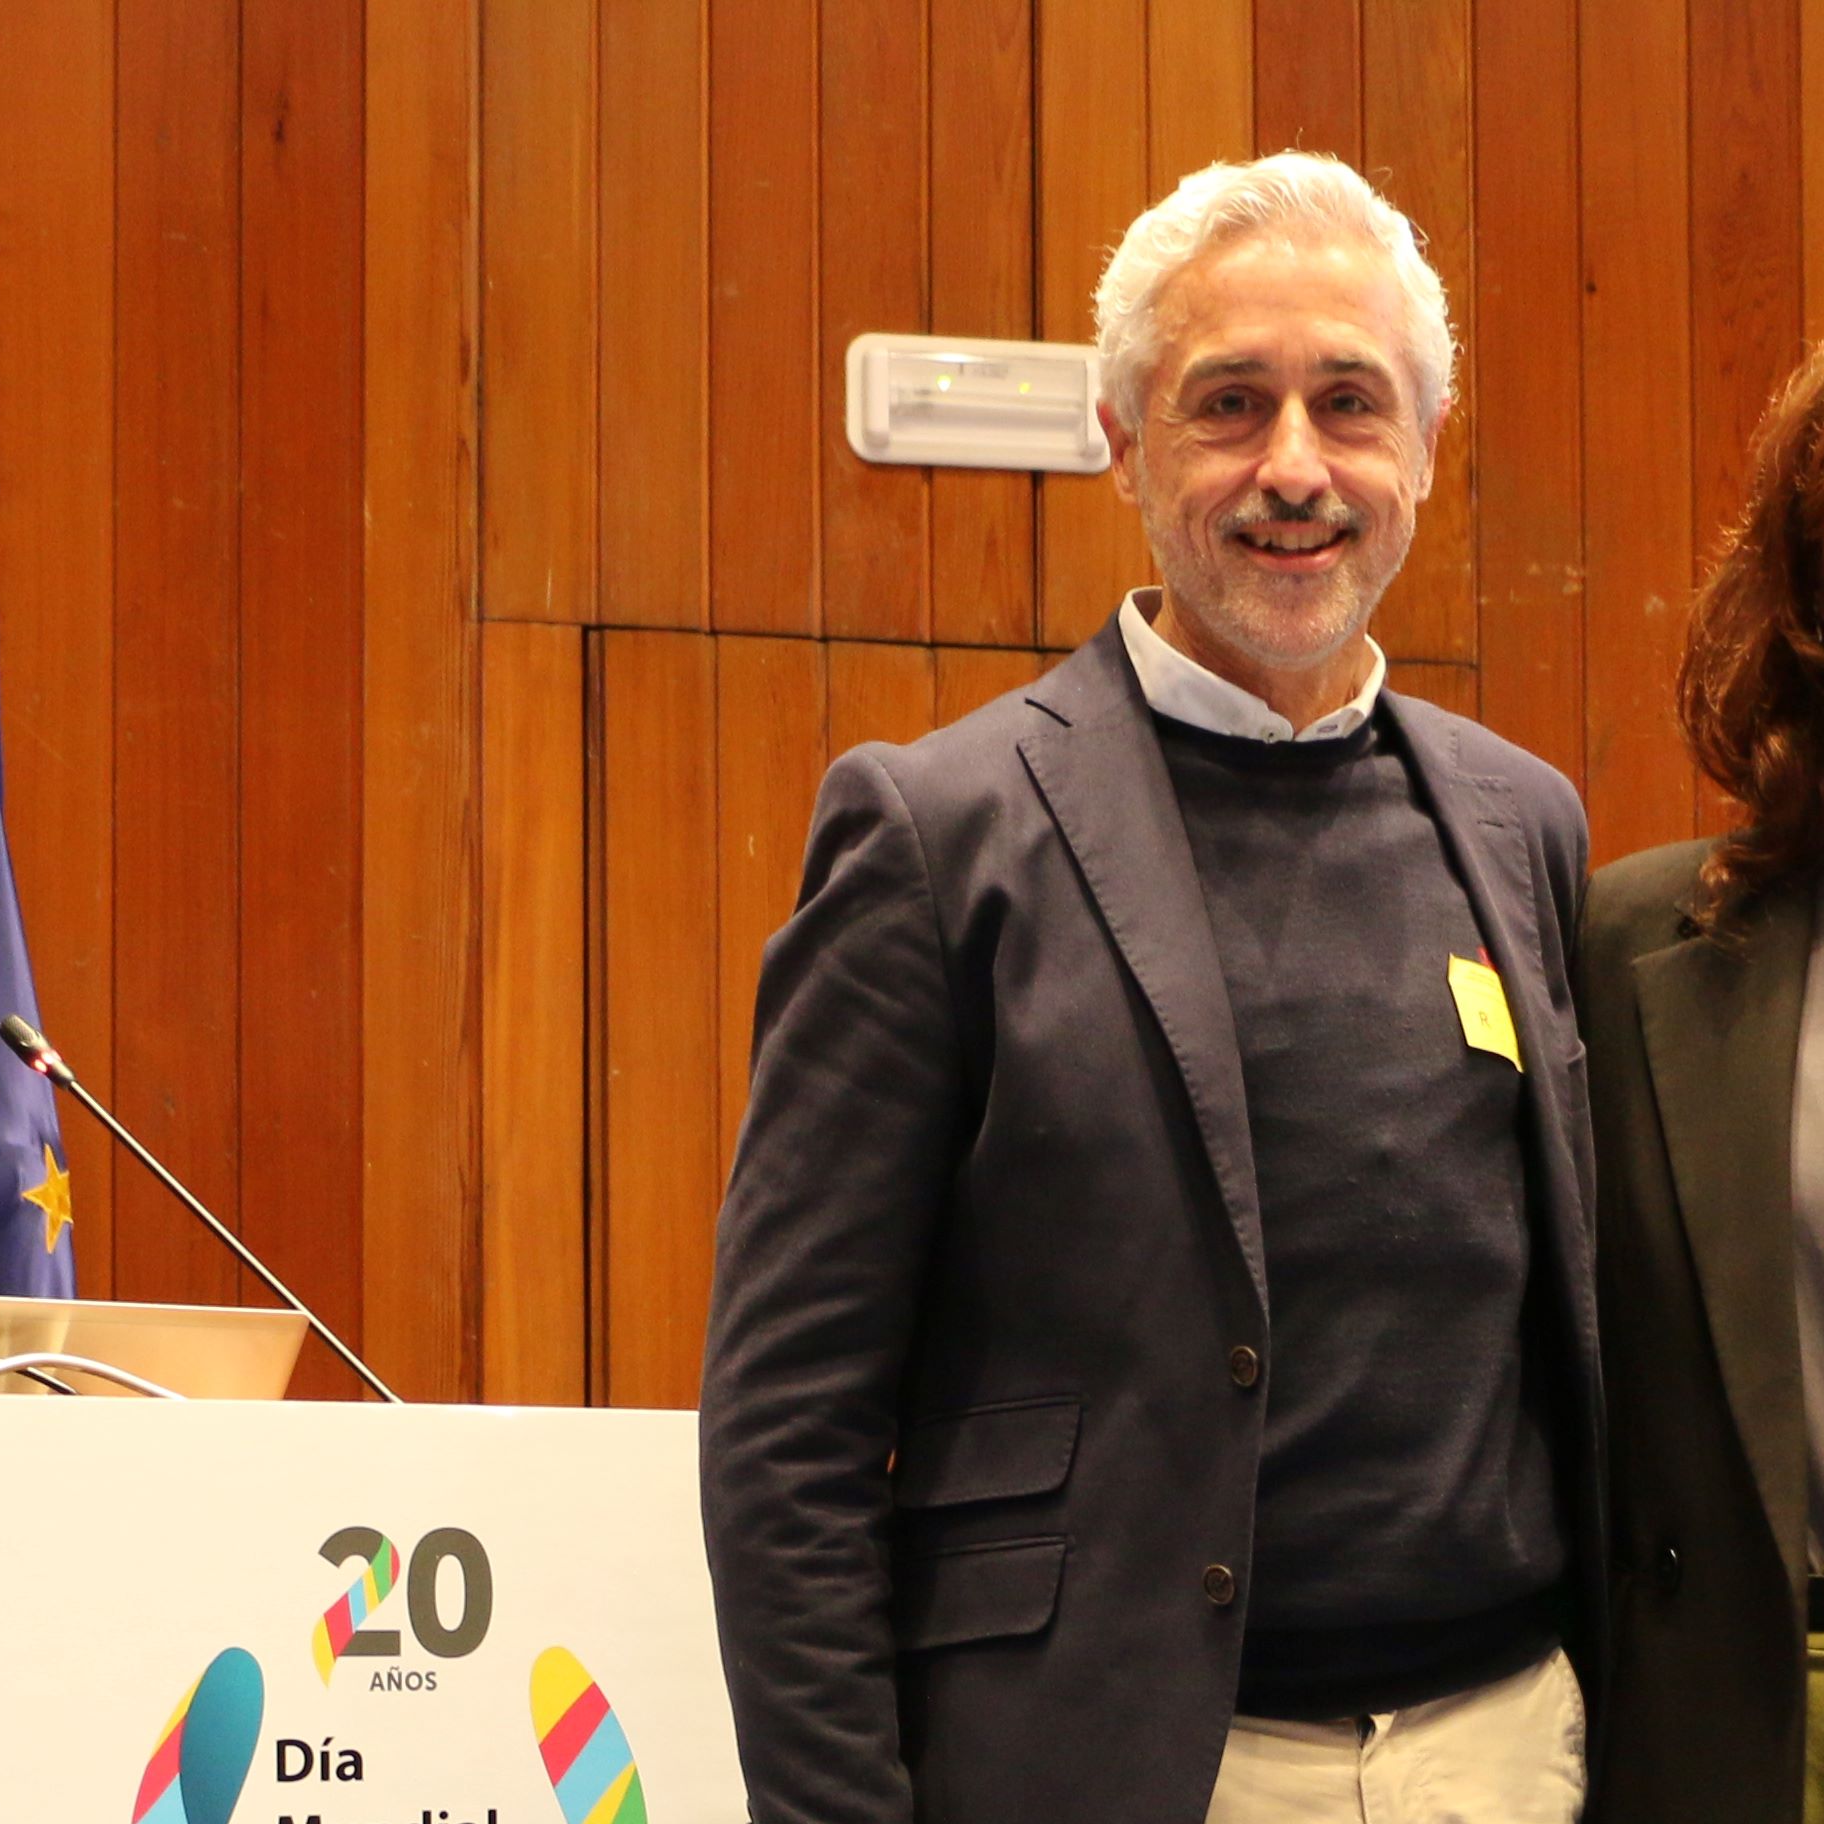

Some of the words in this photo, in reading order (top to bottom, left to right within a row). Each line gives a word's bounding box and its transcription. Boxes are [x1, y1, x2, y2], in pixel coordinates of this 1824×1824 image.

[312, 1526, 493, 1690] 20
[369, 1666, 438, 1692] AÑOS
[275, 1736, 364, 1783] Día
